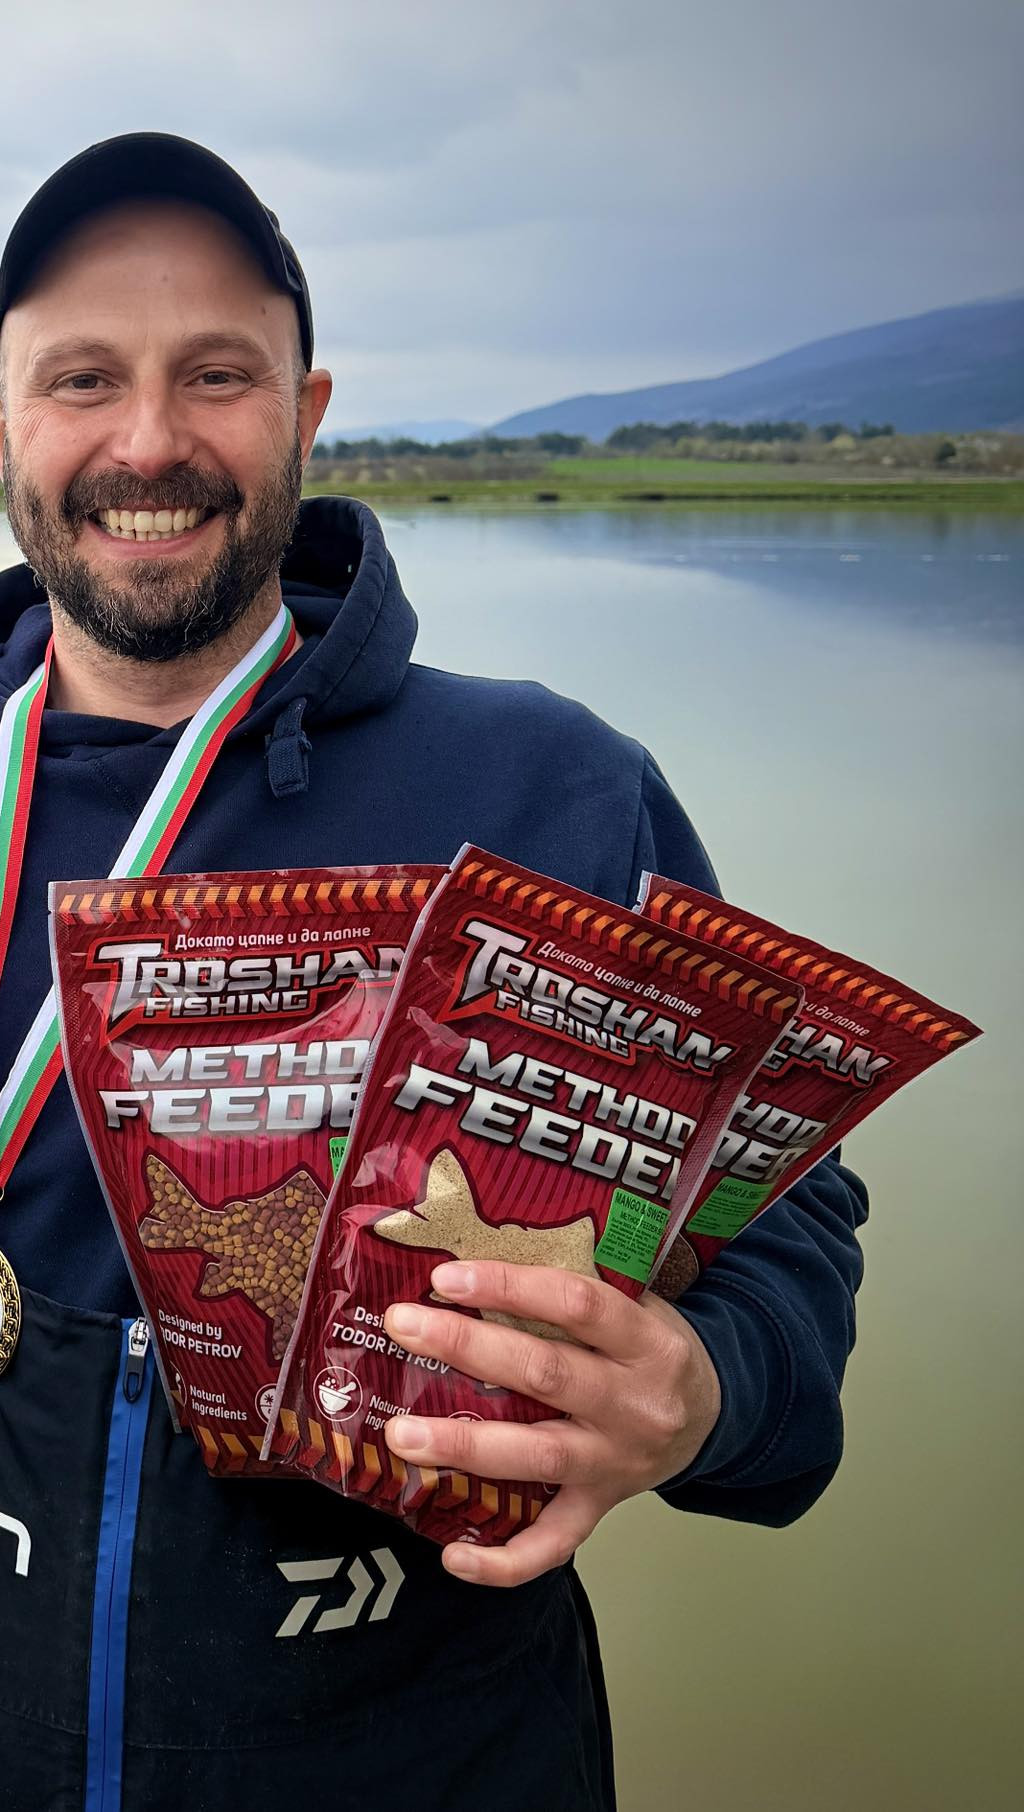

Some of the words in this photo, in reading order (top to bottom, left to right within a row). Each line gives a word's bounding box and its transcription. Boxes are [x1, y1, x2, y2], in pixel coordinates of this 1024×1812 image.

[175, 934, 234, 950] Докато
[238, 933, 284, 948] цапне
[288, 932, 297, 943] и
[301, 928, 319, 942] да
[322, 926, 371, 942] лапне
[461, 920, 732, 1070] TROSHAN
[537, 940, 594, 973] Докато
[594, 966, 634, 990] цапне
[634, 982, 645, 994] и
[643, 983, 661, 1000] да
[659, 991, 702, 1018] лапне
[144, 990, 308, 1017] FISHING
[496, 989, 629, 1057] FISHING
[815, 1005, 830, 1020] да
[831, 1015, 871, 1037] лапне
[131, 1039, 370, 1083] METHO
[98, 1083, 362, 1133] FEEDE
[457, 1037, 697, 1150] METHOD
[615, 1191, 641, 1212] MANGO
[640, 1203, 647, 1215] &
[158, 1308, 204, 1335] Designed
[206, 1322, 222, 1340] by
[354, 1306, 386, 1333] Desi
[188, 1337, 243, 1359] PETROV
[332, 1322, 386, 1354] TODOR
[189, 1385, 226, 1405] Natural
[192, 1400, 247, 1421] ingredients
